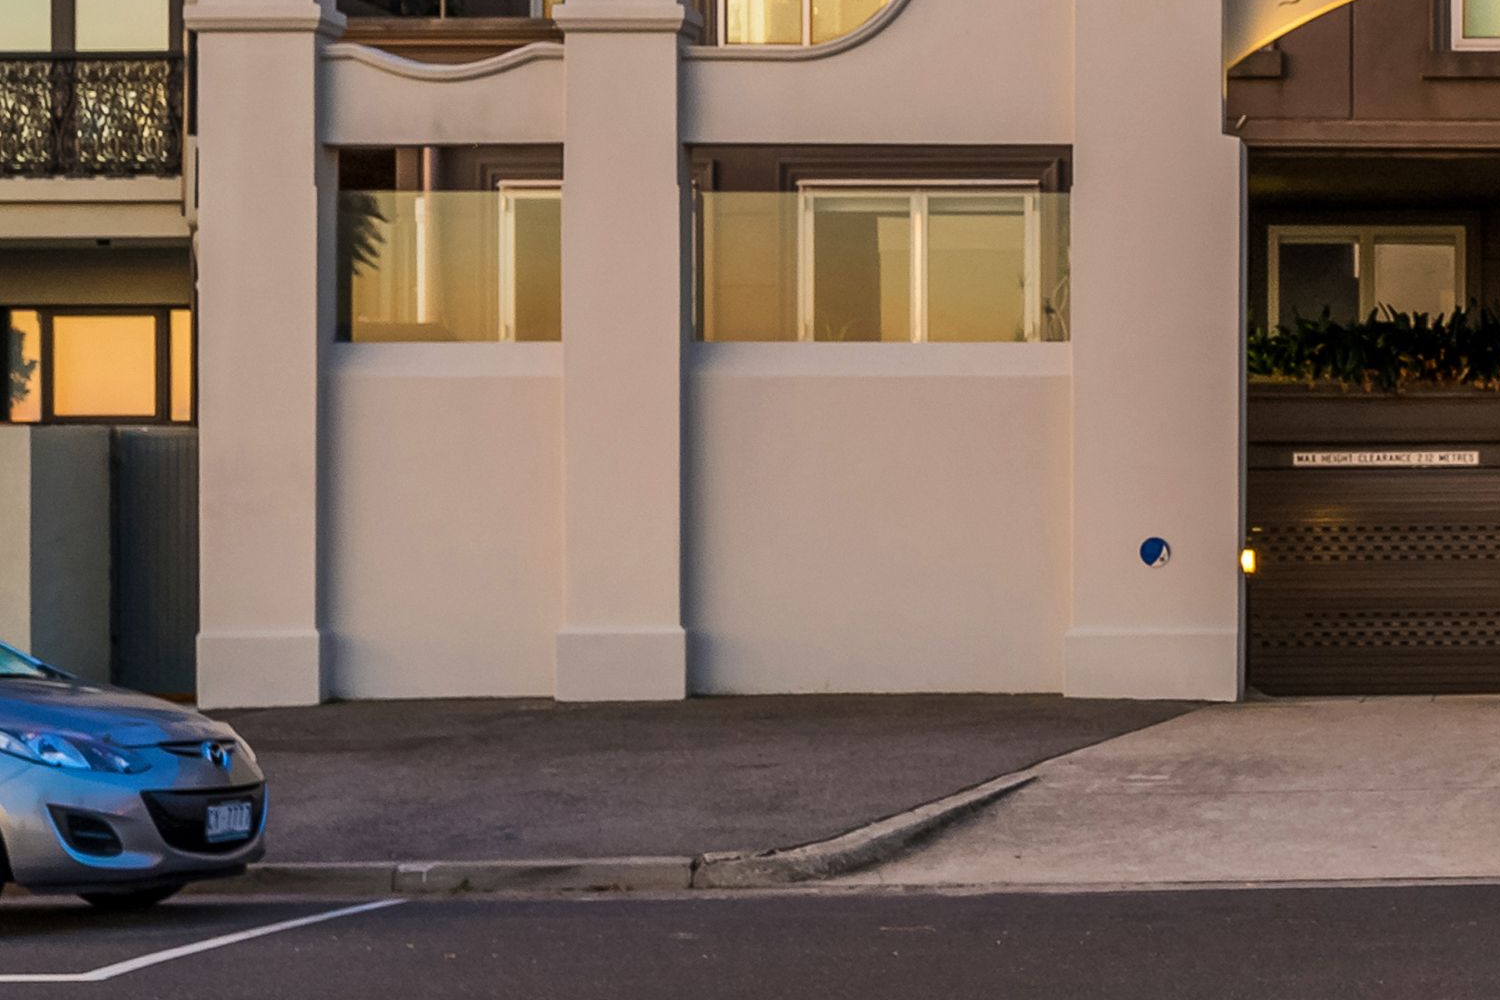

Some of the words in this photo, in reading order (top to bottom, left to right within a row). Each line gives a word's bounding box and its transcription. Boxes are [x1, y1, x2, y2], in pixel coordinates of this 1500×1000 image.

[1320, 454, 1353, 463] HEIGHT
[1357, 453, 1411, 463] CLEARANCE
[1438, 453, 1474, 463] METRES
